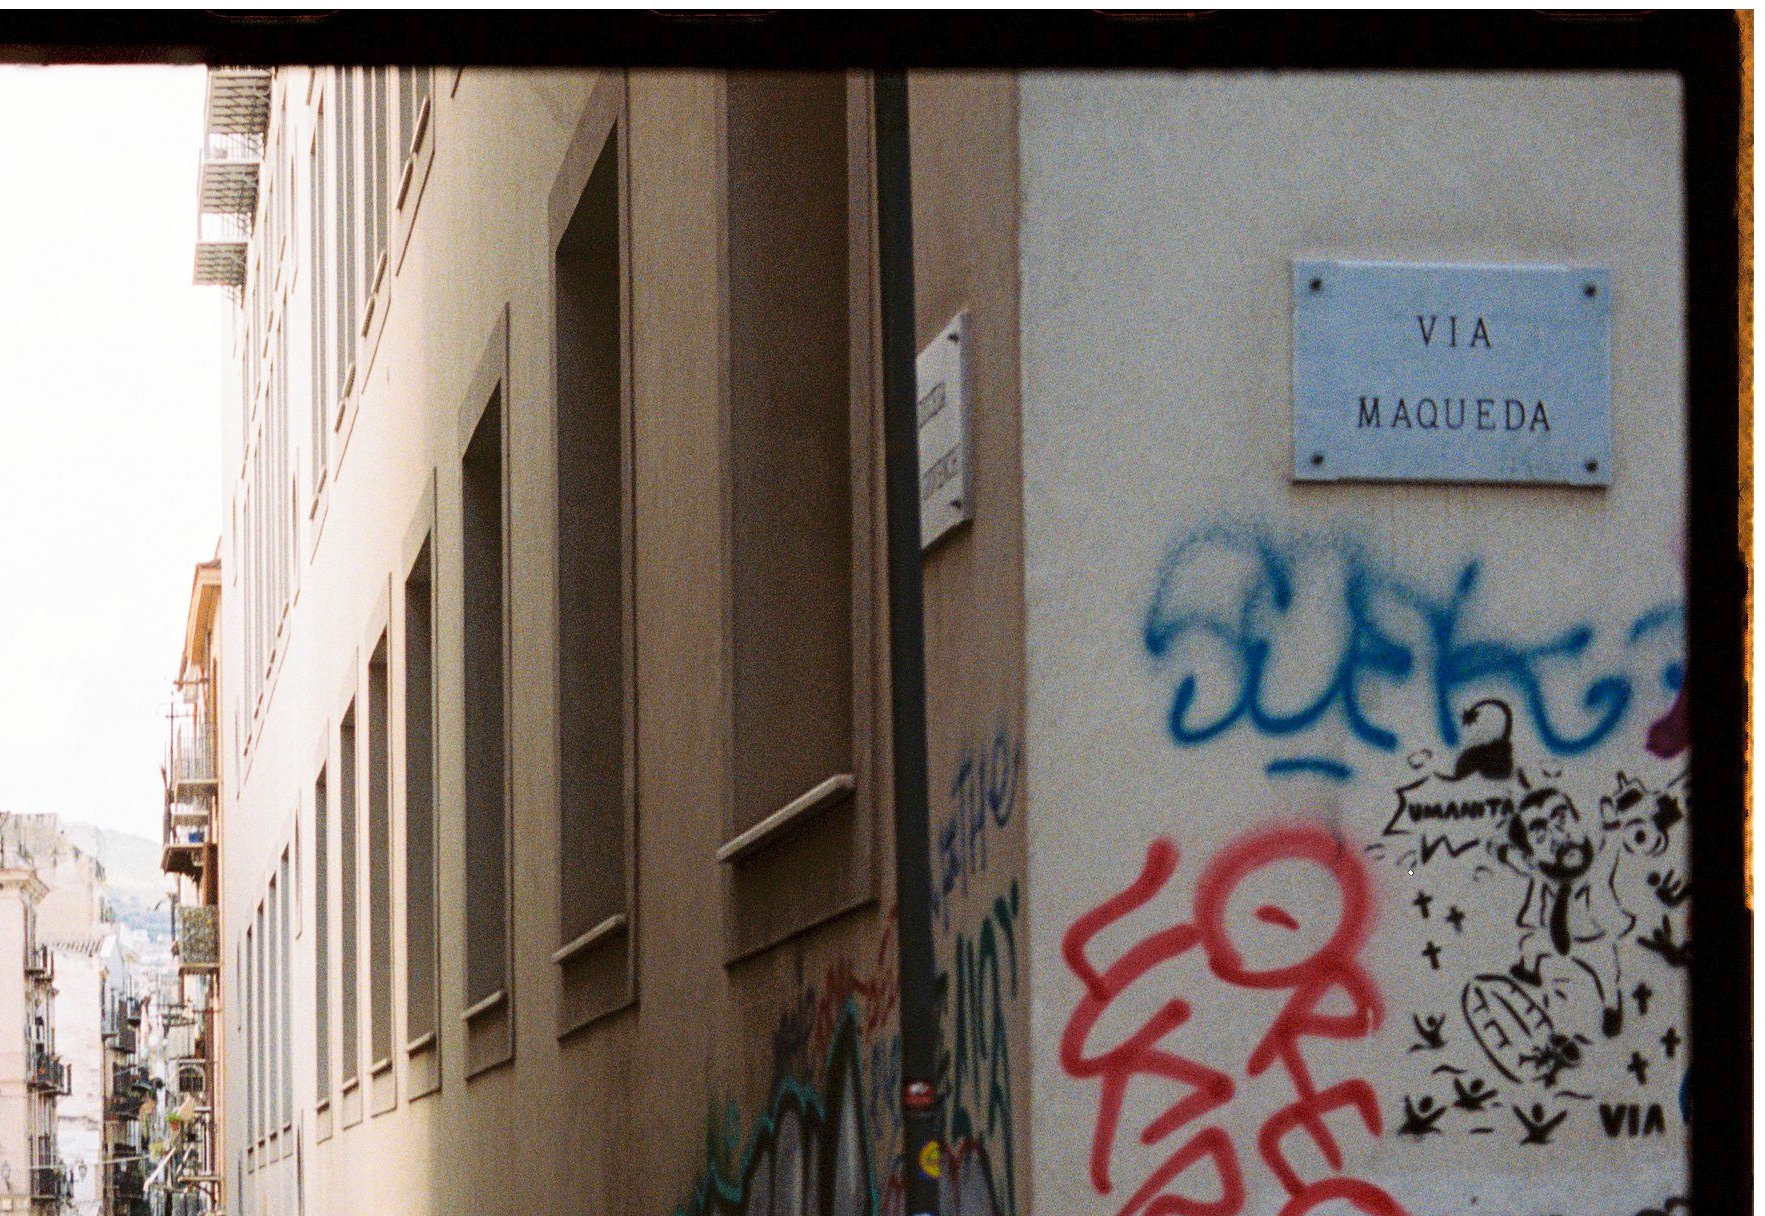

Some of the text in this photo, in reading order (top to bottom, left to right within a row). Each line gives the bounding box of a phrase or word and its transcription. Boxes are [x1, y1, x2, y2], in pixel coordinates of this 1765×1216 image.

[1417, 315, 1493, 348] VIA
[1358, 397, 1551, 432] MAQUEDA
[1598, 1102, 1666, 1138] VIA
